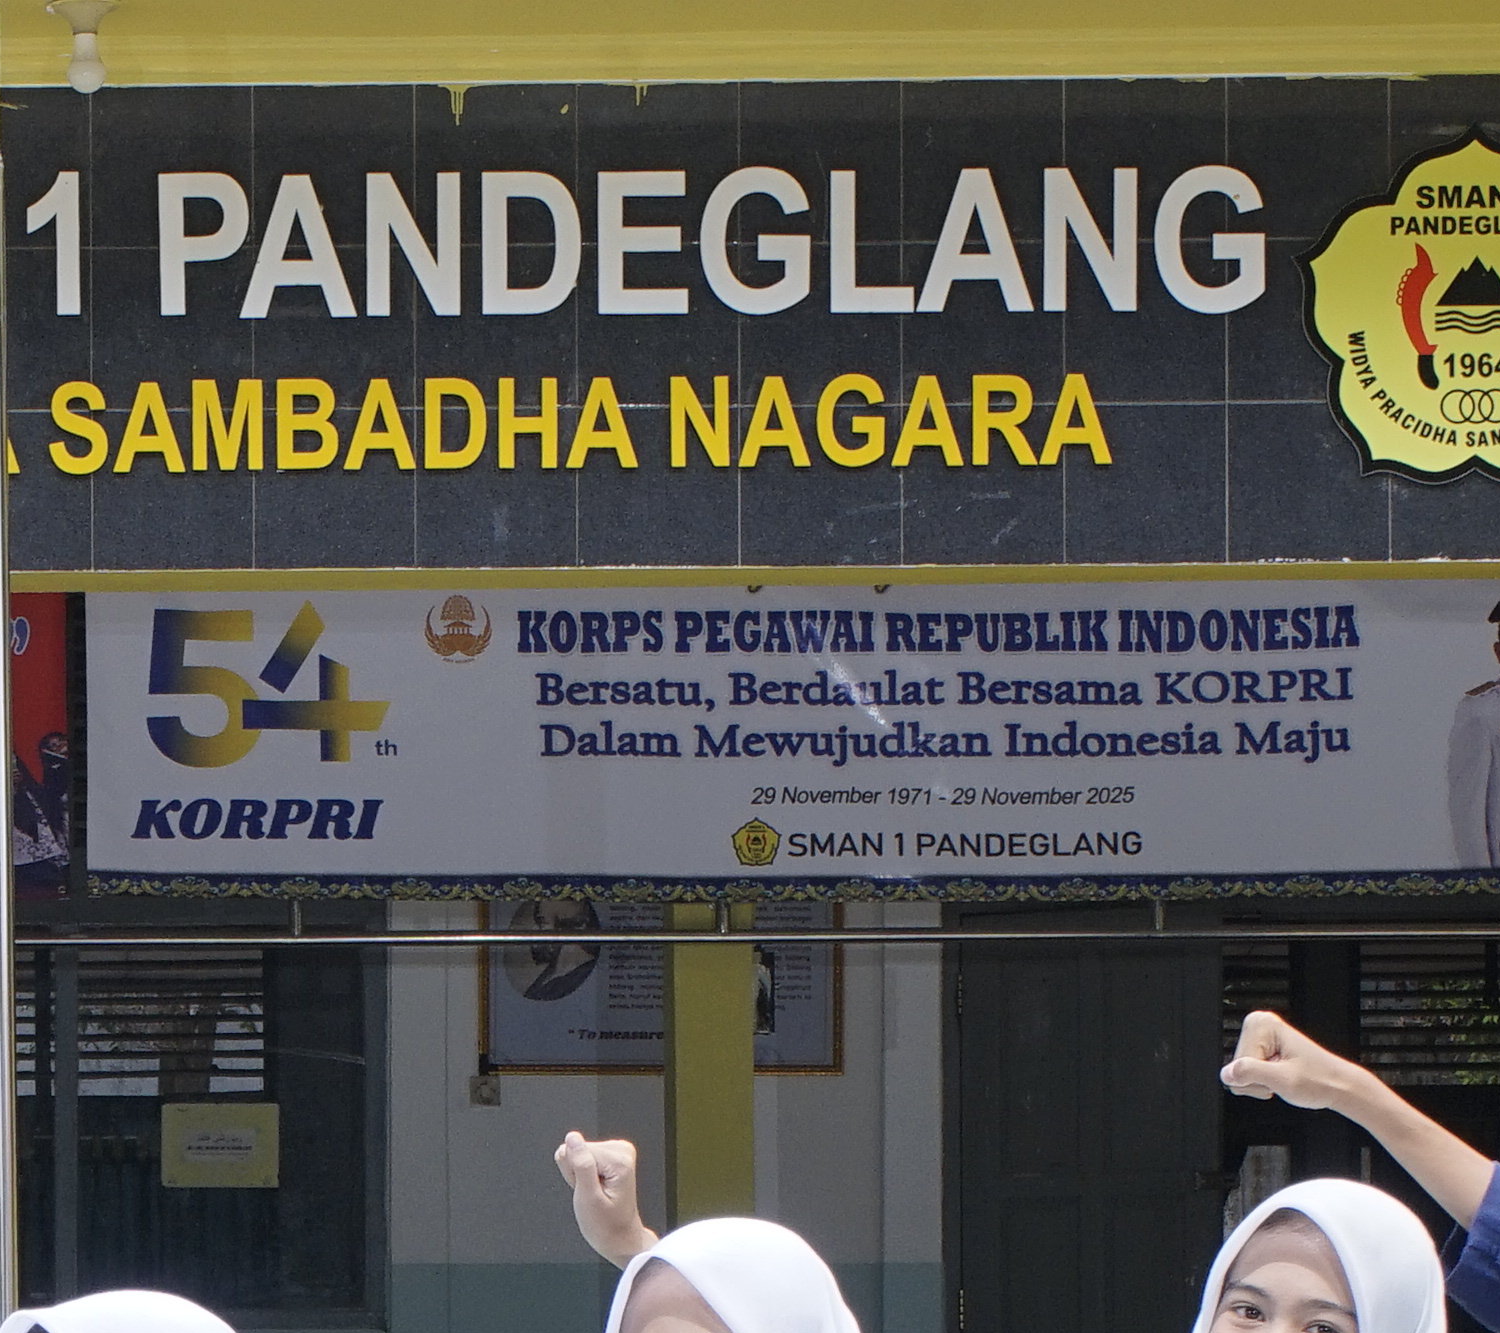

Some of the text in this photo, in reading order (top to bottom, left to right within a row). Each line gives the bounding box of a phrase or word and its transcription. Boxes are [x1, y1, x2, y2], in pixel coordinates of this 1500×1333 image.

[26, 171, 81, 316] 1
[159, 166, 1266, 318] PANDEGLANG
[1347, 329, 1372, 391] WIDYA
[1370, 389, 1458, 447] PRACIDHA
[49, 377, 638, 475] SAMBADHA
[671, 373, 1112, 468] NAGARA
[517, 604, 1360, 654] KORPS PEGAWAI REPUBLIK INDONESIA
[146, 600, 398, 768] 54 th
[534, 666, 1354, 713] Bersatu, Berdaulat Bersama KORPRI
[539, 720, 1351, 767] Dalam Mewujudkan Indonesia Maju
[131, 798, 384, 841] KORPRI
[751, 786, 777, 805] 29
[781, 786, 882, 804] November
[888, 787, 931, 805] 1971
[950, 787, 977, 806] 29
[981, 787, 1082, 806] November
[1086, 786, 1135, 805] 2025
[787, 831, 1142, 857] SMAN 1 PANDEGLANG
